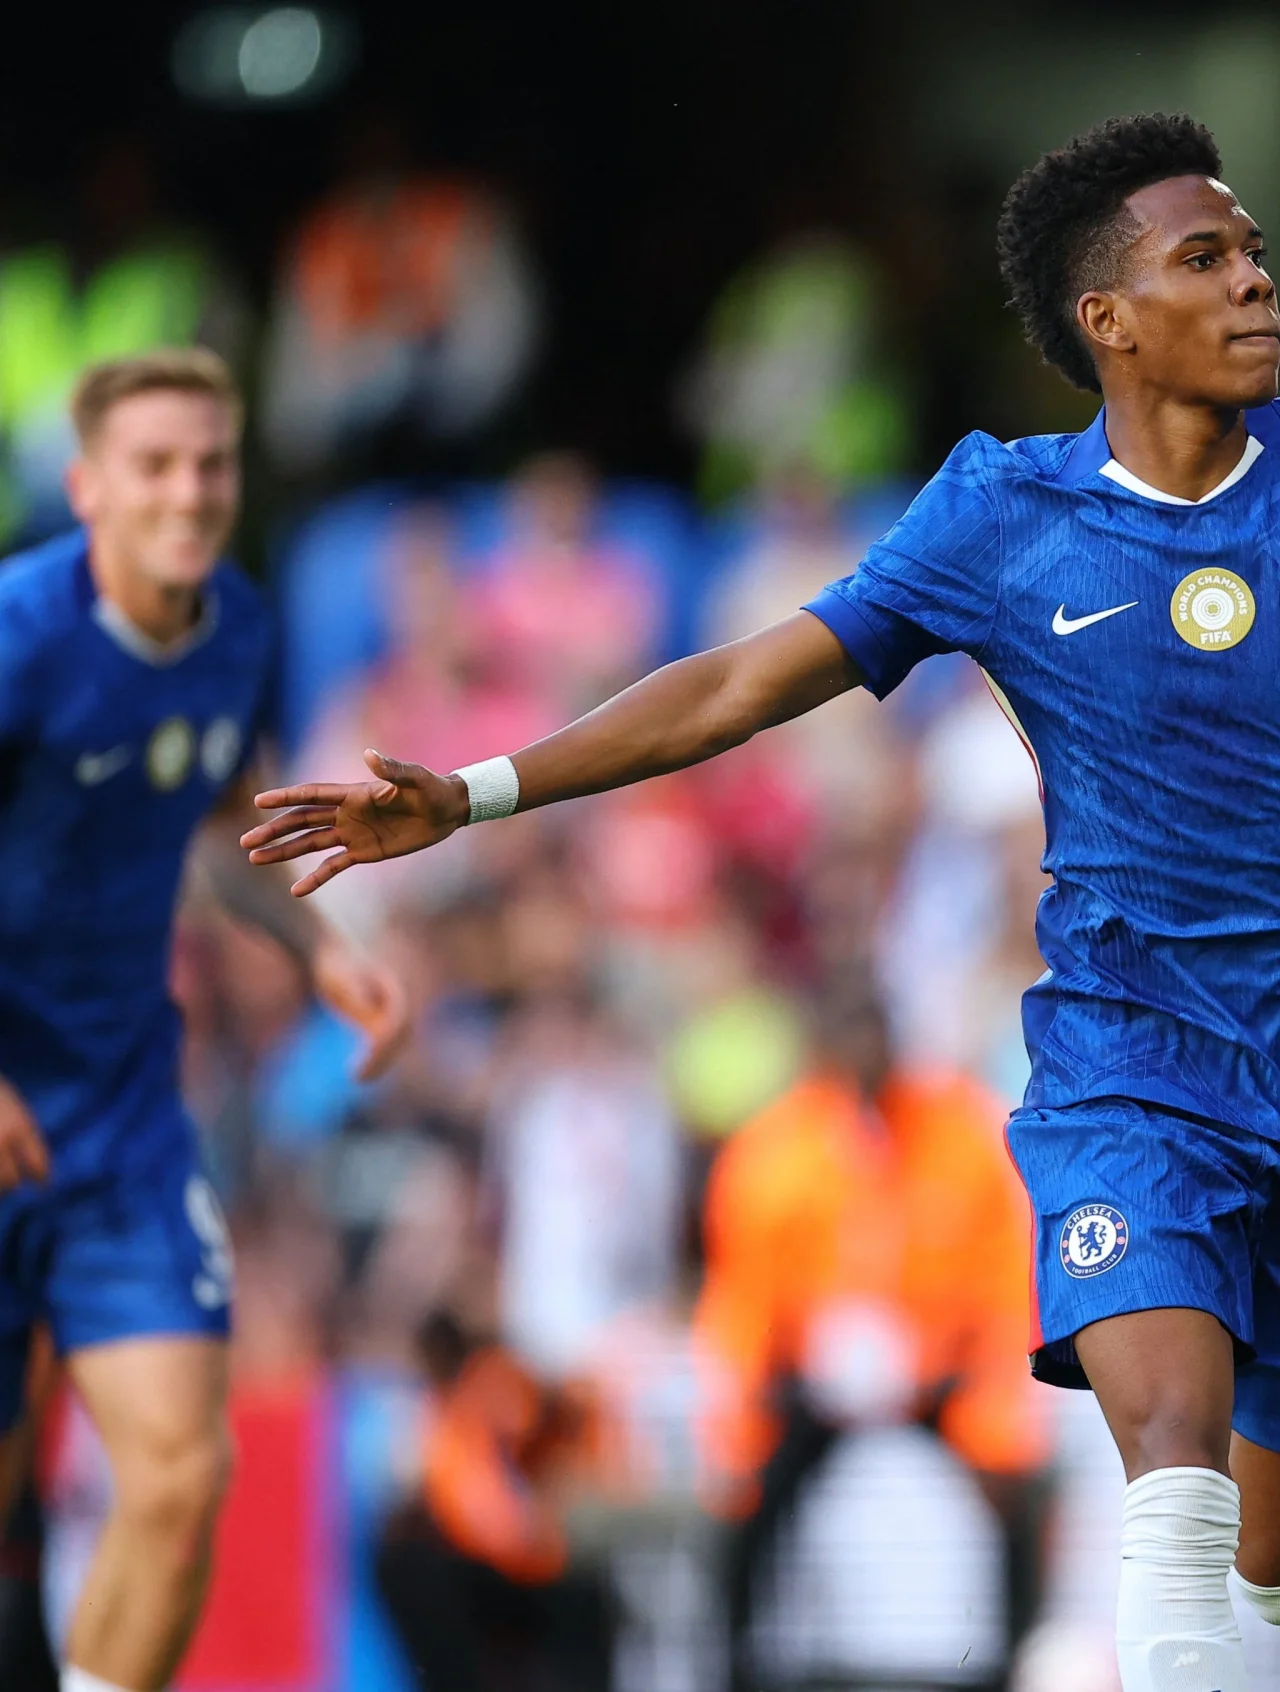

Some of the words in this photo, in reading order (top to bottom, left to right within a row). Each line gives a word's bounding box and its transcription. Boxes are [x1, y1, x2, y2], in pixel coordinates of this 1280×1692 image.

[1178, 583, 1197, 622] WORLD
[1197, 575, 1248, 615] CHAMPIONS
[1200, 630, 1232, 645] FIFA
[1067, 1206, 1112, 1230] CHELSEA
[1071, 1266, 1099, 1275] FOOTBALL
[1101, 1253, 1118, 1268] CLUB
